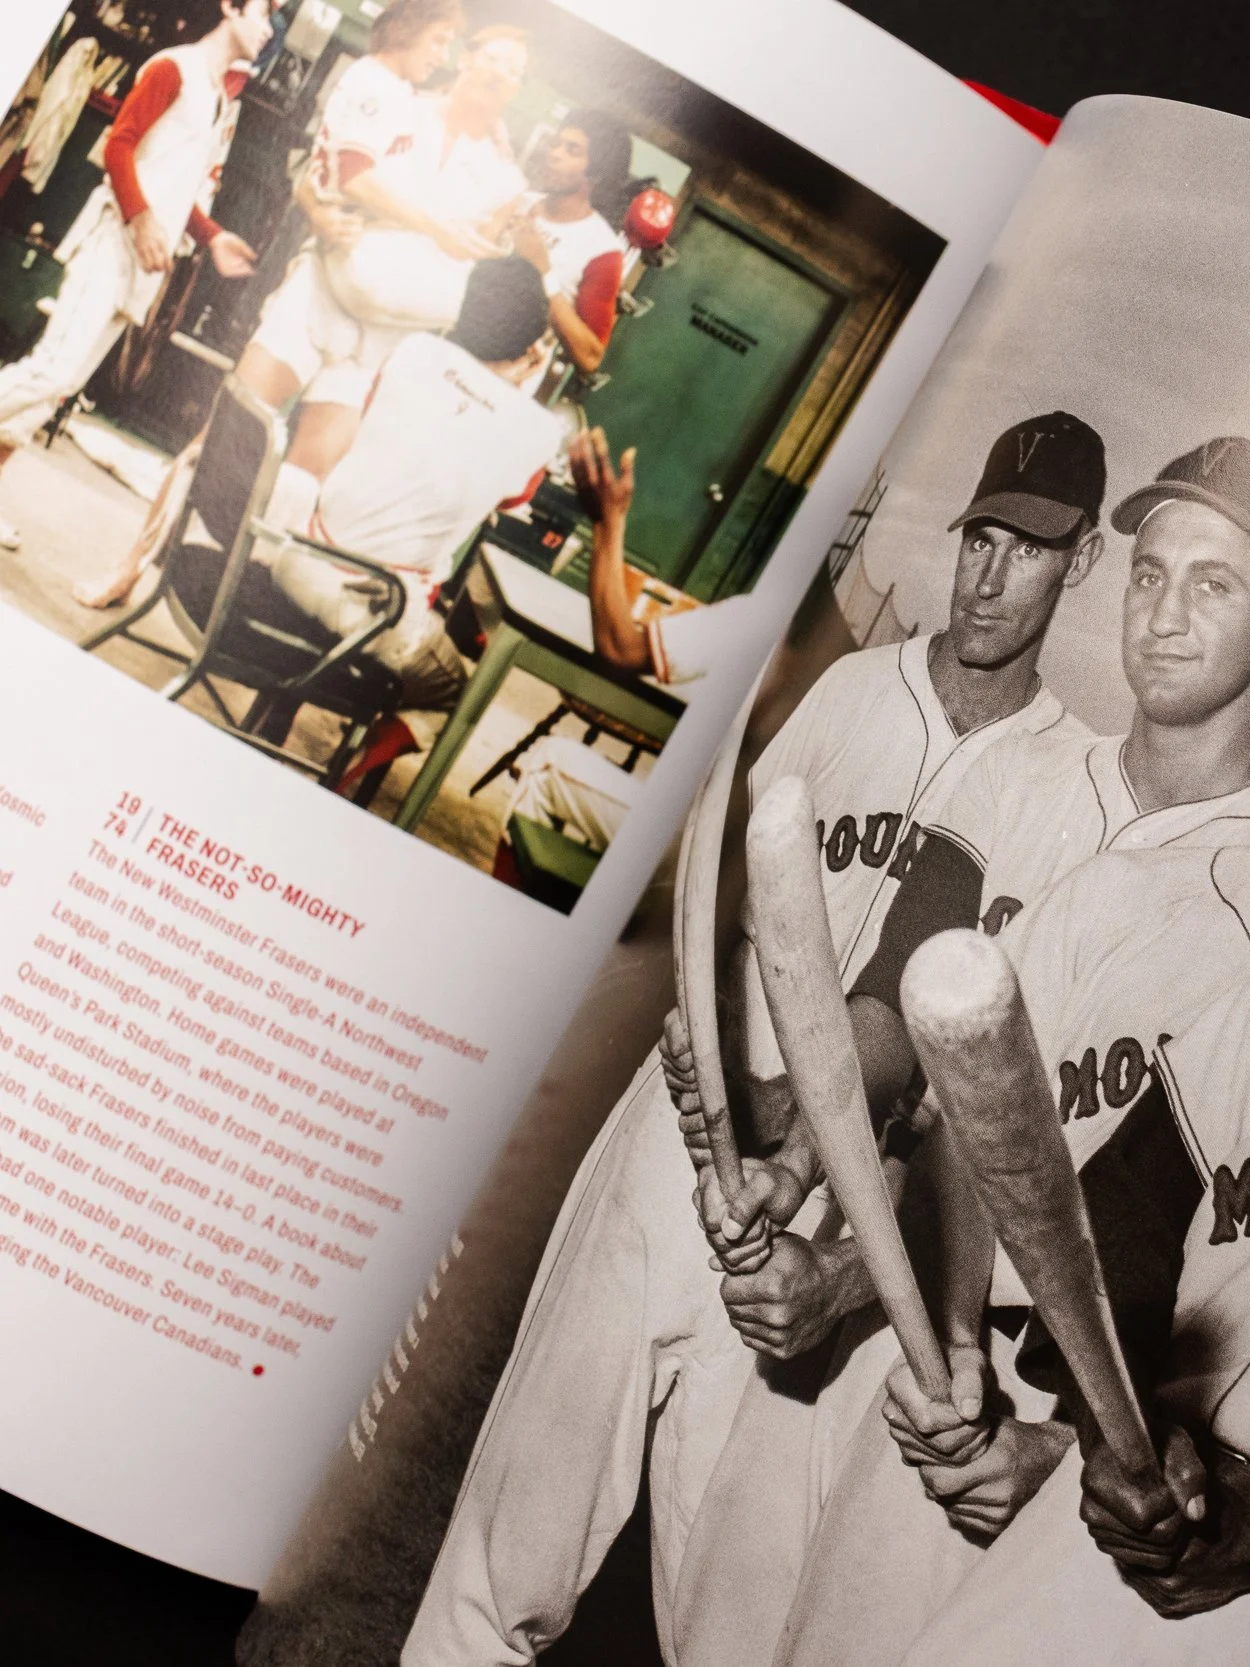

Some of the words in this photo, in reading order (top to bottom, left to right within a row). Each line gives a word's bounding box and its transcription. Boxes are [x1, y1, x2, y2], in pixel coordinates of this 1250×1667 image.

[1016, 432, 1044, 473] V
[1202, 441, 1238, 476] V
[105, 812, 127, 837] 74
[117, 791, 143, 815] 19
[146, 835, 239, 900] FRASERS
[160, 813, 200, 847] THE
[201, 839, 365, 937] NOT-SO-MIGHTY
[70, 872, 110, 902] team
[111, 898, 129, 915] in
[130, 906, 157, 931] the
[158, 924, 264, 990] short-season
[267, 980, 338, 1027] Single-A
[338, 1019, 423, 1070] Northwest
[88, 838, 119, 869] The
[120, 859, 155, 888] New
[158, 883, 258, 945] Westminster
[259, 936, 322, 982] Frasers
[325, 976, 364, 1003] were
[367, 996, 390, 1014] an
[391, 1009, 488, 1062] independent
[17, 961, 82, 1009] Queen's
[84, 1000, 121, 1030] Park
[199, 1067, 249, 1102] where
[252, 1092, 280, 1116] the
[279, 1110, 341, 1148] players
[344, 1140, 384, 1167] were
[33, 934, 67, 959] and
[168, 1008, 217, 1045] Home
[216, 1039, 275, 1075] games
[277, 1070, 317, 1096] were
[319, 1091, 377, 1123] played
[376, 1118, 395, 1133] at
[53, 1028, 151, 1088] undisturbed
[151, 1077, 172, 1100] by
[173, 1094, 220, 1125] noise
[221, 1115, 261, 1145] from
[261, 1140, 320, 1179] paying
[116, 943, 204, 1001] competing
[203, 991, 267, 1031] against
[267, 1023, 318, 1059] teams
[320, 1048, 373, 1085] based
[373, 1076, 389, 1093] in
[390, 1083, 449, 1119] Oregon
[1059, 1033, 1173, 1125] MO
[15, 1043, 88, 1093] sad-sack
[89, 1084, 151, 1128] Frasers
[155, 1119, 223, 1165] finished
[222, 1158, 241, 1174] in
[241, 1166, 274, 1190] last
[272, 1184, 322, 1214] place
[323, 1204, 339, 1221] in
[344, 1212, 379, 1239] their
[18, 1127, 50, 1152] was
[54, 1146, 92, 1172] later
[92, 1167, 148, 1205] turned
[150, 1197, 182, 1222] into
[183, 1216, 196, 1231] a
[197, 1224, 246, 1254] stage
[291, 1263, 321, 1289] The
[32, 1093, 83, 1134] losing
[85, 1121, 122, 1150] their
[125, 1143, 162, 1173] final
[161, 1167, 210, 1198] game
[262, 1215, 275, 1229] A
[278, 1219, 319, 1250] book
[319, 1243, 367, 1270] about
[22, 1211, 58, 1236] with
[61, 1229, 88, 1252] the
[161, 1279, 214, 1315] Seven
[214, 1310, 260, 1339] years
[24, 1169, 57, 1197] one
[56, 1188, 122, 1231] notable
[182, 1255, 214, 1278] Lee
[219, 1269, 280, 1307] Sigman
[280, 1301, 336, 1332] played
[32, 1254, 61, 1278] the
[63, 1269, 150, 1324] Vancouver
